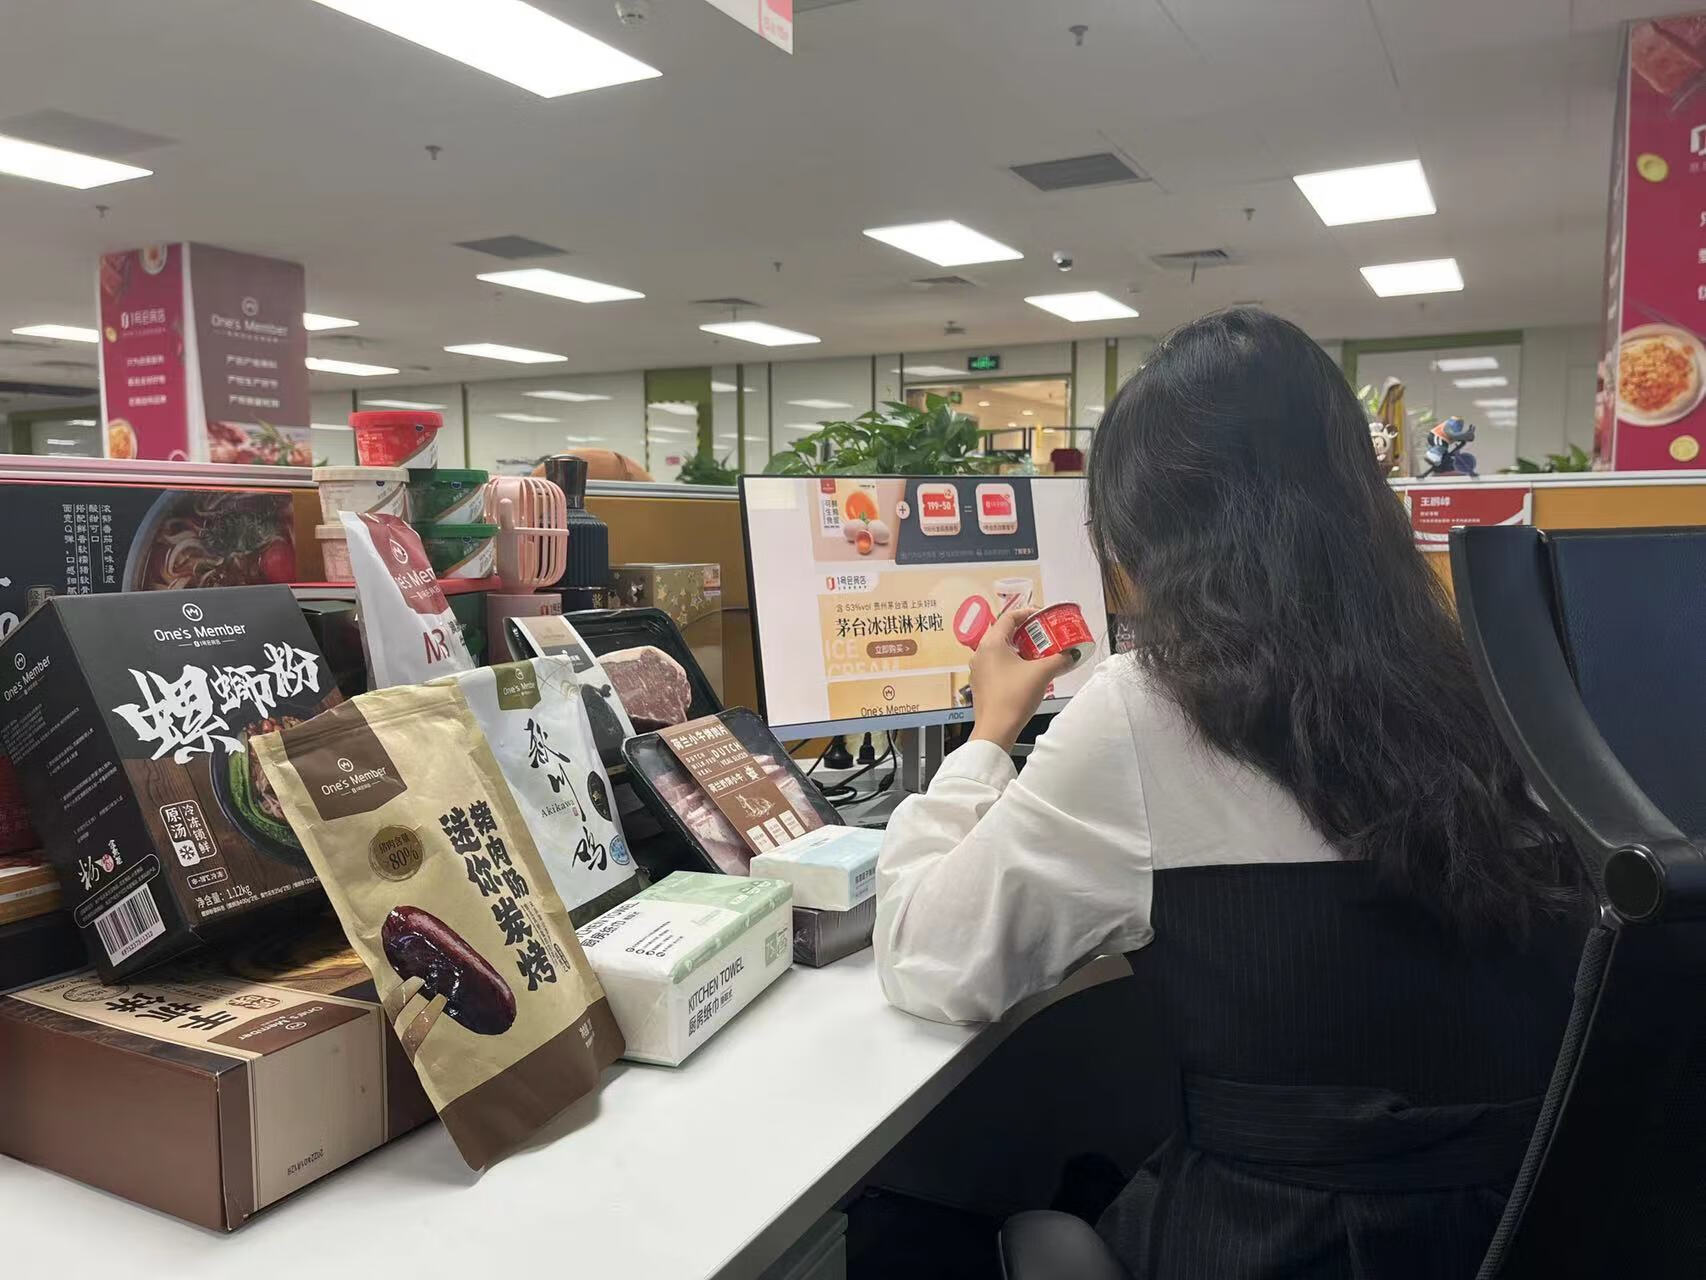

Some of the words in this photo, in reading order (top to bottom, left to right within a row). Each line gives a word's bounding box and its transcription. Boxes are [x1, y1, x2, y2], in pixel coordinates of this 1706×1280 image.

[927, 501, 952, 510] 199-50
[88, 504, 100, 543] 酸甜可口
[154, 628, 192, 642] One's
[193, 624, 246, 639] Member
[835, 613, 944, 637] 茅台冰淇淋来啦
[874, 644, 904, 655] 立即购买
[4, 681, 23, 702] One's
[22, 655, 52, 686] Member
[112, 641, 320, 764] 螺蛳粉
[861, 705, 883, 717] One's
[885, 703, 919, 714] Member
[685, 752, 706, 763] DUTCH
[711, 742, 743, 759] DUTCH
[321, 779, 350, 796] One's
[350, 766, 387, 785] Member
[697, 768, 713, 777] VEAL
[540, 799, 575, 819] Akikawa
[165, 807, 188, 839] 原汤
[389, 847, 420, 871] 80%
[226, 885, 253, 899] 1.12kg
[688, 976, 719, 1014] KITCHEN
[720, 956, 745, 986] TOWEL
[105, 992, 238, 1031] 手抓饼
[689, 997, 720, 1037] 厨房纸巾
